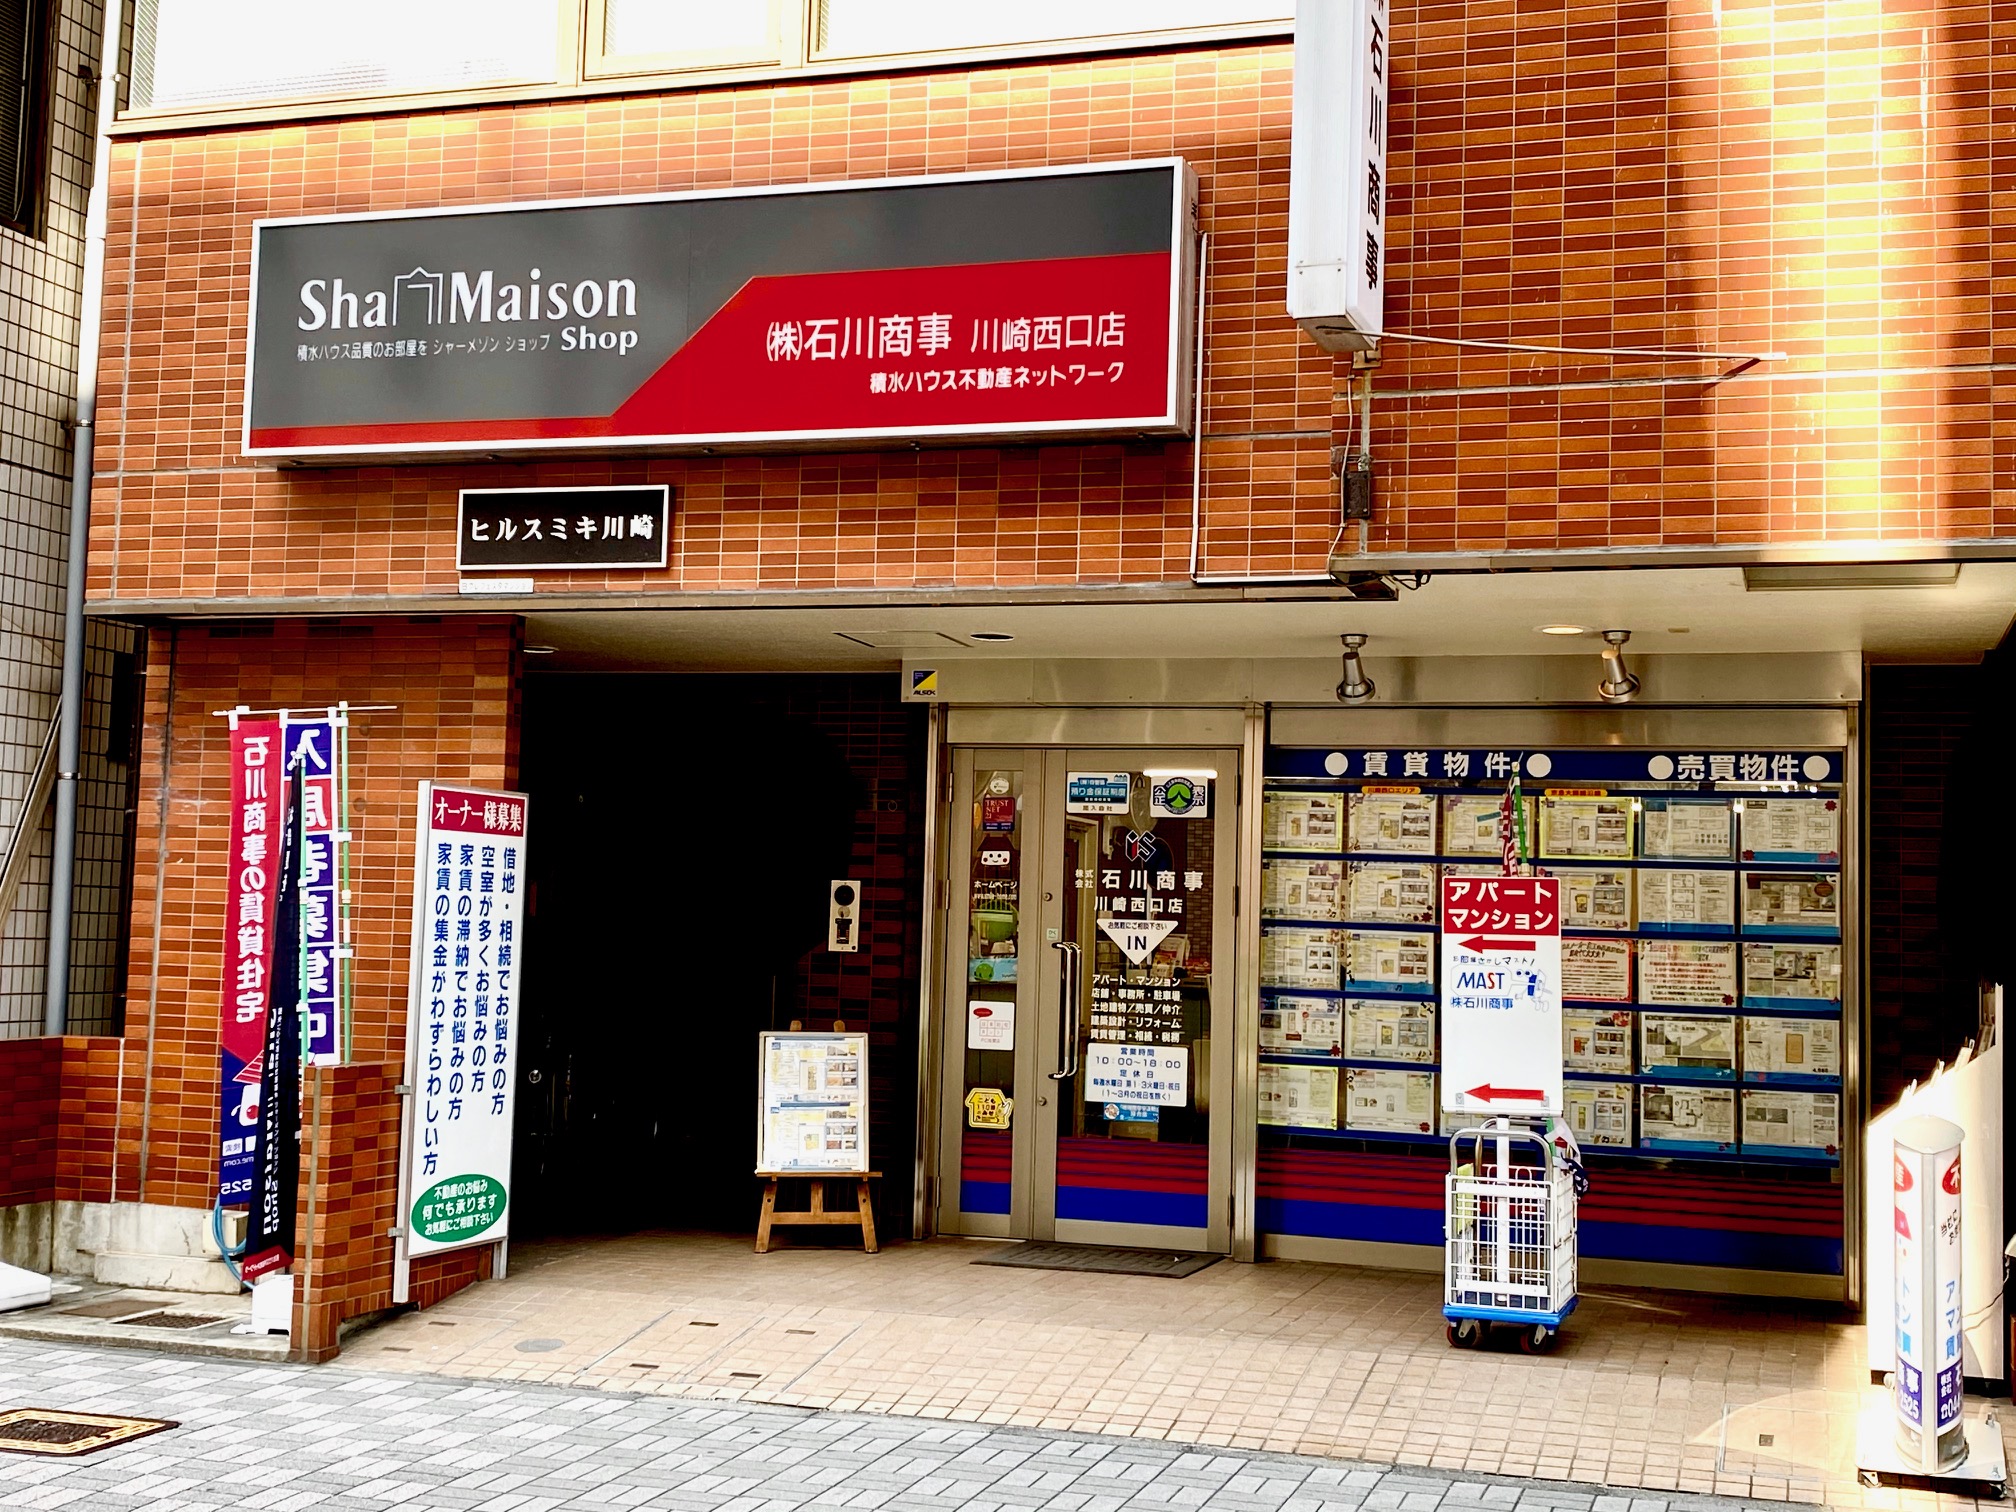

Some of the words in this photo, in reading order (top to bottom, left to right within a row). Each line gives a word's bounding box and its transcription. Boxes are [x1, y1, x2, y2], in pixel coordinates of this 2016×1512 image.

[297, 278, 388, 332] Sha
[449, 267, 638, 325] Maison
[560, 324, 639, 357] Shop
[971, 311, 1126, 354] 川崎西口店
[297, 338, 428, 363] 積水ハウス品質のお部屋を
[433, 336, 500, 356] シャーメゾン
[505, 332, 551, 354] ショップ
[869, 361, 1125, 395] 積水ハウス不動産ネットワーク
[470, 514, 654, 542] ヒルスミキ川崎
[1362, 751, 1512, 778] 賃貸物件
[1676, 753, 1801, 782] 売買物件
[434, 796, 523, 833] オーナー様募集
[973, 880, 1018, 890] ホームページ
[1101, 869, 1204, 892] 石川商事
[1449, 881, 1553, 905] アパート
[1093, 895, 1184, 914] 川崎西口店
[1447, 908, 1555, 931] マンション
[1126, 935, 1148, 951] IN
[448, 844, 475, 1121] 家賃の滞納でお悩みの方
[471, 845, 496, 1093] 空室が多くお悩みの方
[491, 847, 517, 1116] 借地・相続でお悩みの方
[1092, 974, 1181, 988] アパート・マンション
[1456, 972, 1506, 990] MAST
[422, 842, 453, 1176] 家賃の集金がわずらわしい方
[1120, 1047, 1155, 1058] 営業時間
[1119, 1069, 1154, 1079] 定休日
[433, 1178, 489, 1200] 不動産のお悩み
[421, 1193, 498, 1221] 何でも承ります
[424, 1211, 494, 1237] お気軽にご相談下さい
